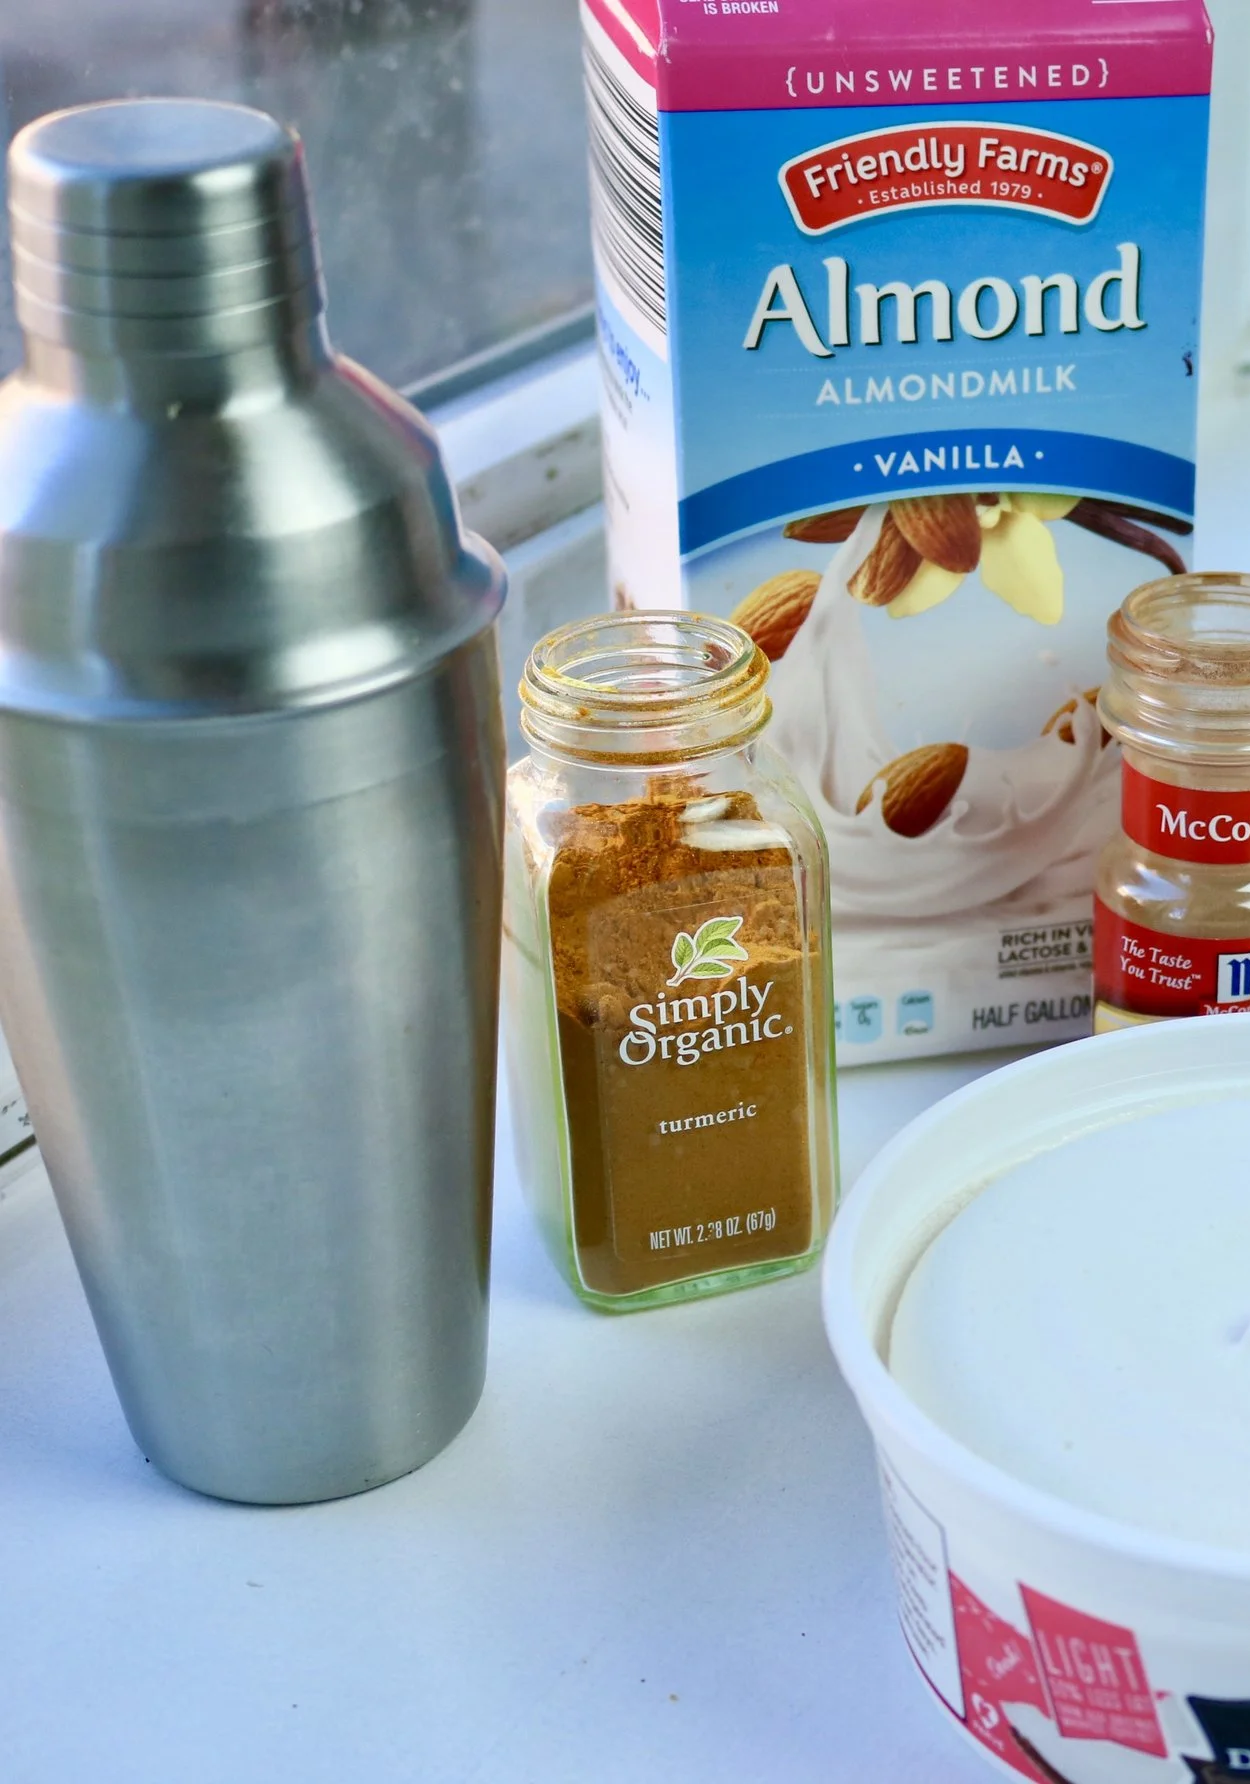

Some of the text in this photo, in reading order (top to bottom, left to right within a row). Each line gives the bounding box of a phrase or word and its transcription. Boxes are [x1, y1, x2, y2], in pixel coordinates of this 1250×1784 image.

[703, 1, 779, 15] IS BROKEN
[803, 137, 966, 199] Friendly
[869, 180, 1033, 205] Established 1979
[743, 242, 1148, 358] Almond
[816, 364, 1078, 407] ALMONDMILK
[874, 444, 1025, 478] VANILLA
[998, 942, 1071, 965] LACTOSE
[1001, 930, 1047, 948] RICH
[1052, 926, 1071, 942] IN
[1120, 936, 1193, 970] The Taste
[1120, 956, 1146, 980] You
[629, 976, 774, 1036] Simply
[972, 1003, 1020, 1031] HALF
[659, 1101, 758, 1135] turmeric
[650, 1229, 671, 1250] NET
[674, 1226, 694, 1246] WT.
[726, 1216, 743, 1236] OZ
[746, 1207, 776, 1235] (67g)
[1036, 1629, 1139, 1693] LIGHT
